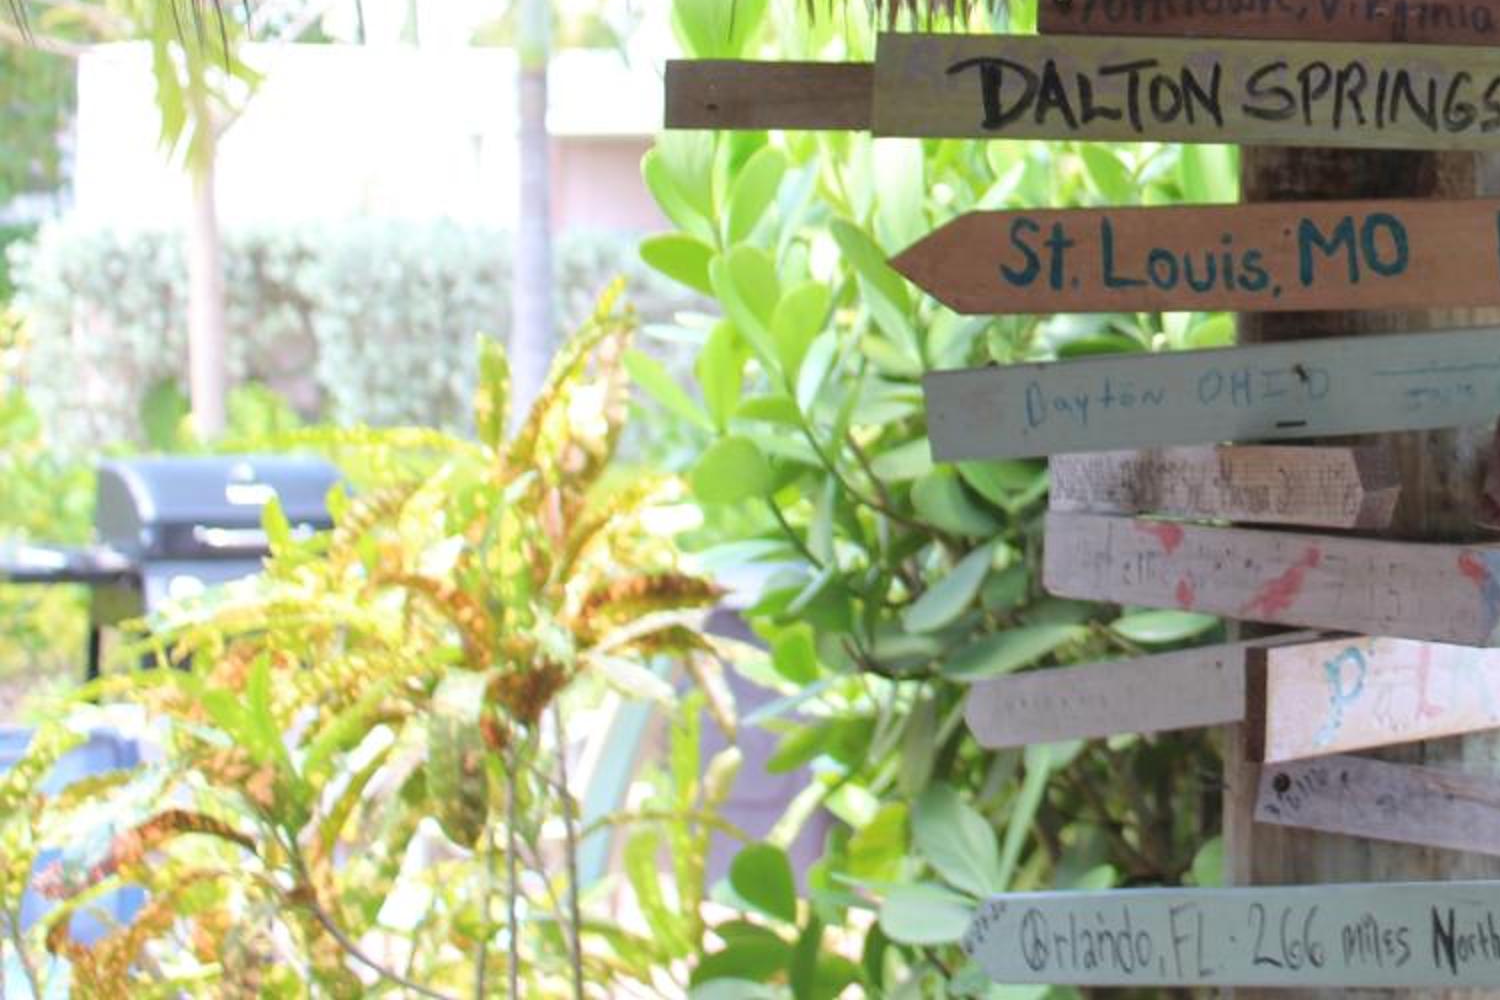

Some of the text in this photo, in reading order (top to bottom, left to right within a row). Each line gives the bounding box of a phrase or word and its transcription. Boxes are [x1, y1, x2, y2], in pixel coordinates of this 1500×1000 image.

[945, 56, 1223, 131] DALTON
[1001, 216, 1082, 292] St.
[1102, 217, 1283, 299] Louis,
[1299, 213, 1410, 287] MO
[1022, 376, 1167, 430] Dayton
[1248, 902, 1327, 971] 266
